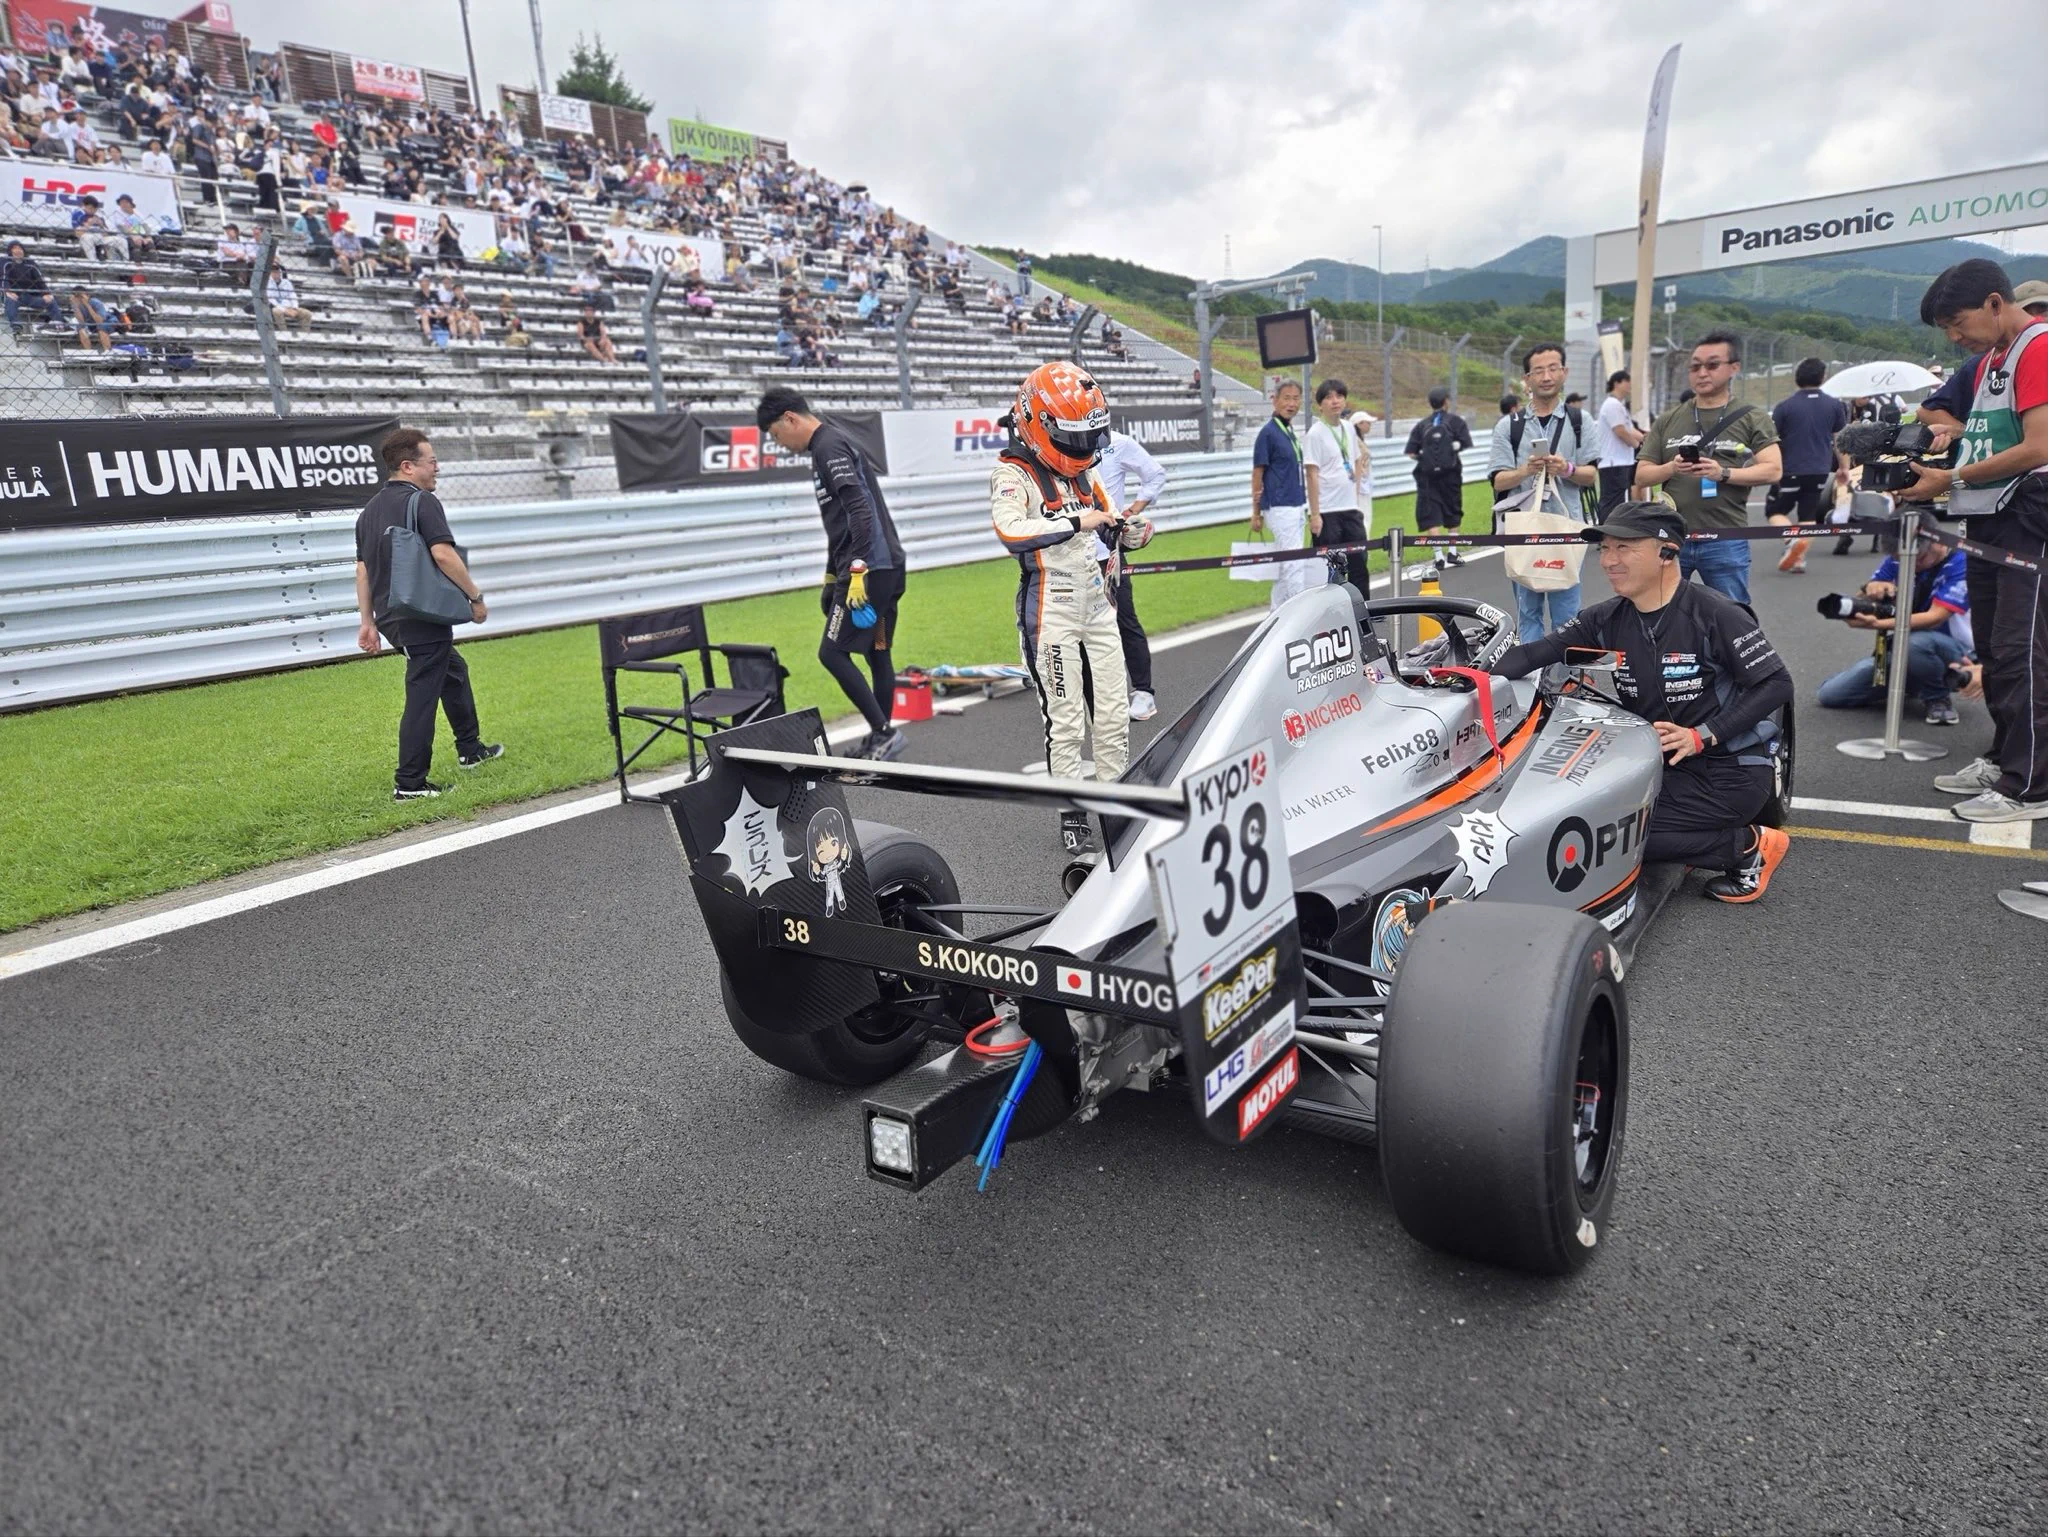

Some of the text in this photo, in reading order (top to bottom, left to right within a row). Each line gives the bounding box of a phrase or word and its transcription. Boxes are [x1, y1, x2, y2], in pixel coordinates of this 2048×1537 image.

[674, 125, 752, 154] UKYOMAN
[1721, 188, 2048, 253] Panasonic AUTOMO
[1128, 419, 1178, 443] HUMAN
[88, 446, 298, 499] HUMAN
[296, 445, 374, 465] MOTOR
[301, 466, 378, 488] SPORTS
[704, 444, 758, 470] GR
[1052, 644, 1066, 699] INGING
[1297, 661, 1357, 693] RACING PADS
[1665, 678, 1703, 688] INGING
[1304, 694, 1362, 731] NICHIBO
[1360, 728, 1440, 775] Felix88
[1529, 726, 1595, 776] INGING
[1202, 801, 1270, 938] 38
[783, 918, 811, 944] 38
[918, 942, 1039, 987] S.KOKORO
[1206, 950, 1276, 1037] KeePer
[1207, 1049, 1244, 1101] LHG
[1243, 1056, 1296, 1132] MOTUL
